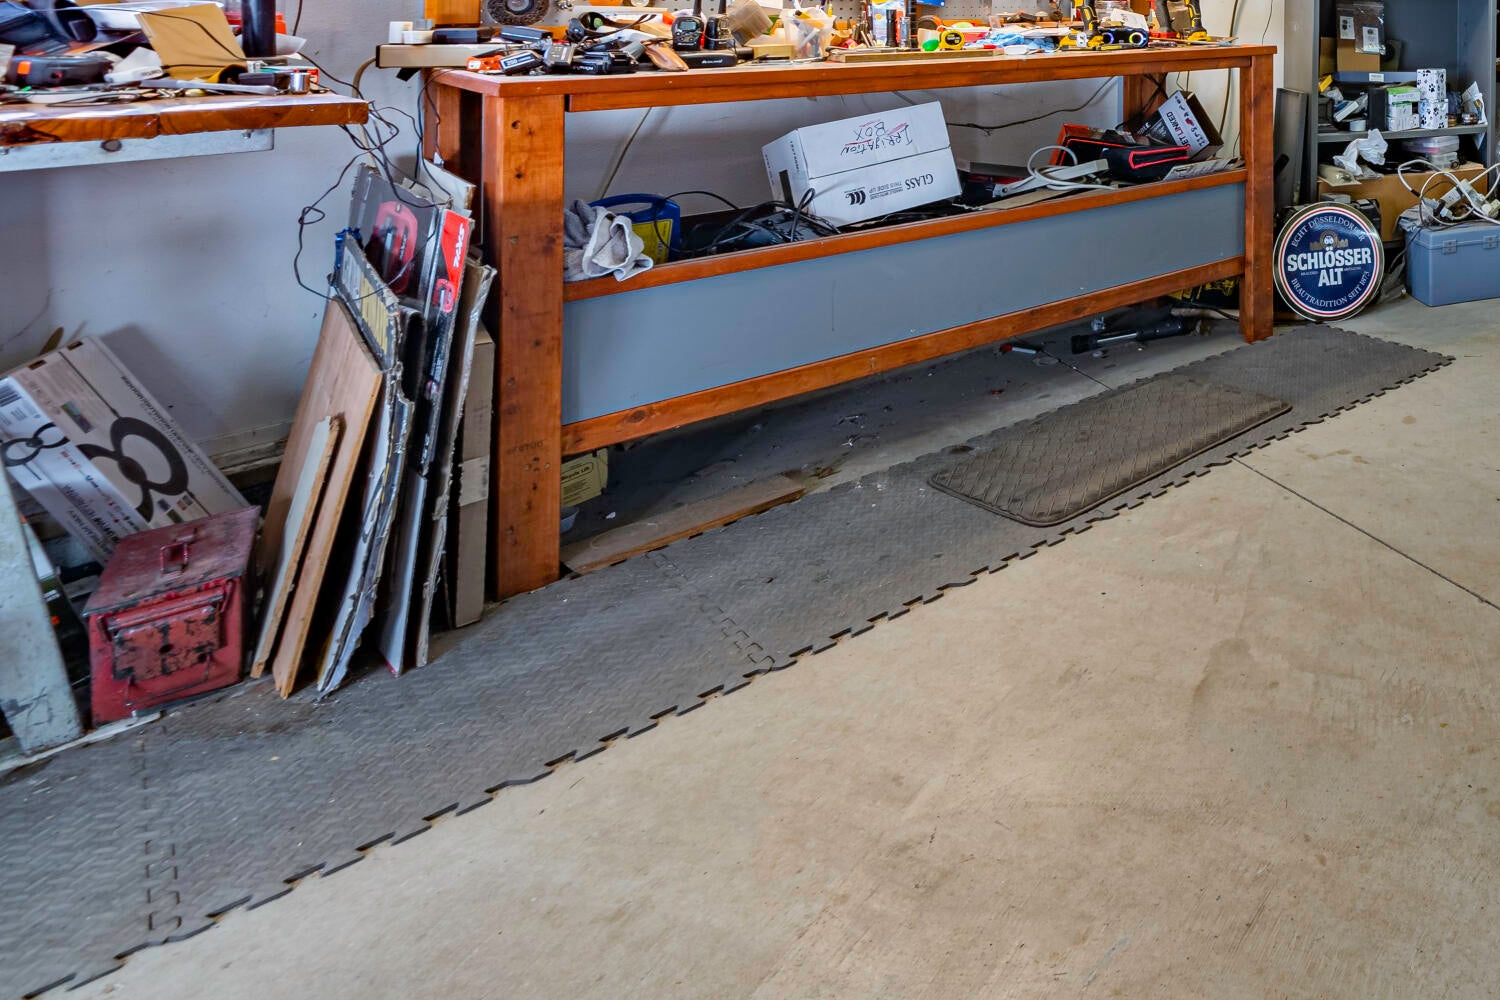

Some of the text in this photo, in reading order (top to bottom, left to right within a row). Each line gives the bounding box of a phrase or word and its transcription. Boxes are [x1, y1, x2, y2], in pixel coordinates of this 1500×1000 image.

[904, 173, 934, 191] GLASS
[1291, 215, 1367, 248] ECHT DÜSSELDORFER
[1287, 246, 1372, 272] SCHLÖSSER
[1317, 267, 1344, 287] ALT
[1291, 277, 1348, 308] BRAUTRADITION
[1348, 284, 1362, 301] SEIT
